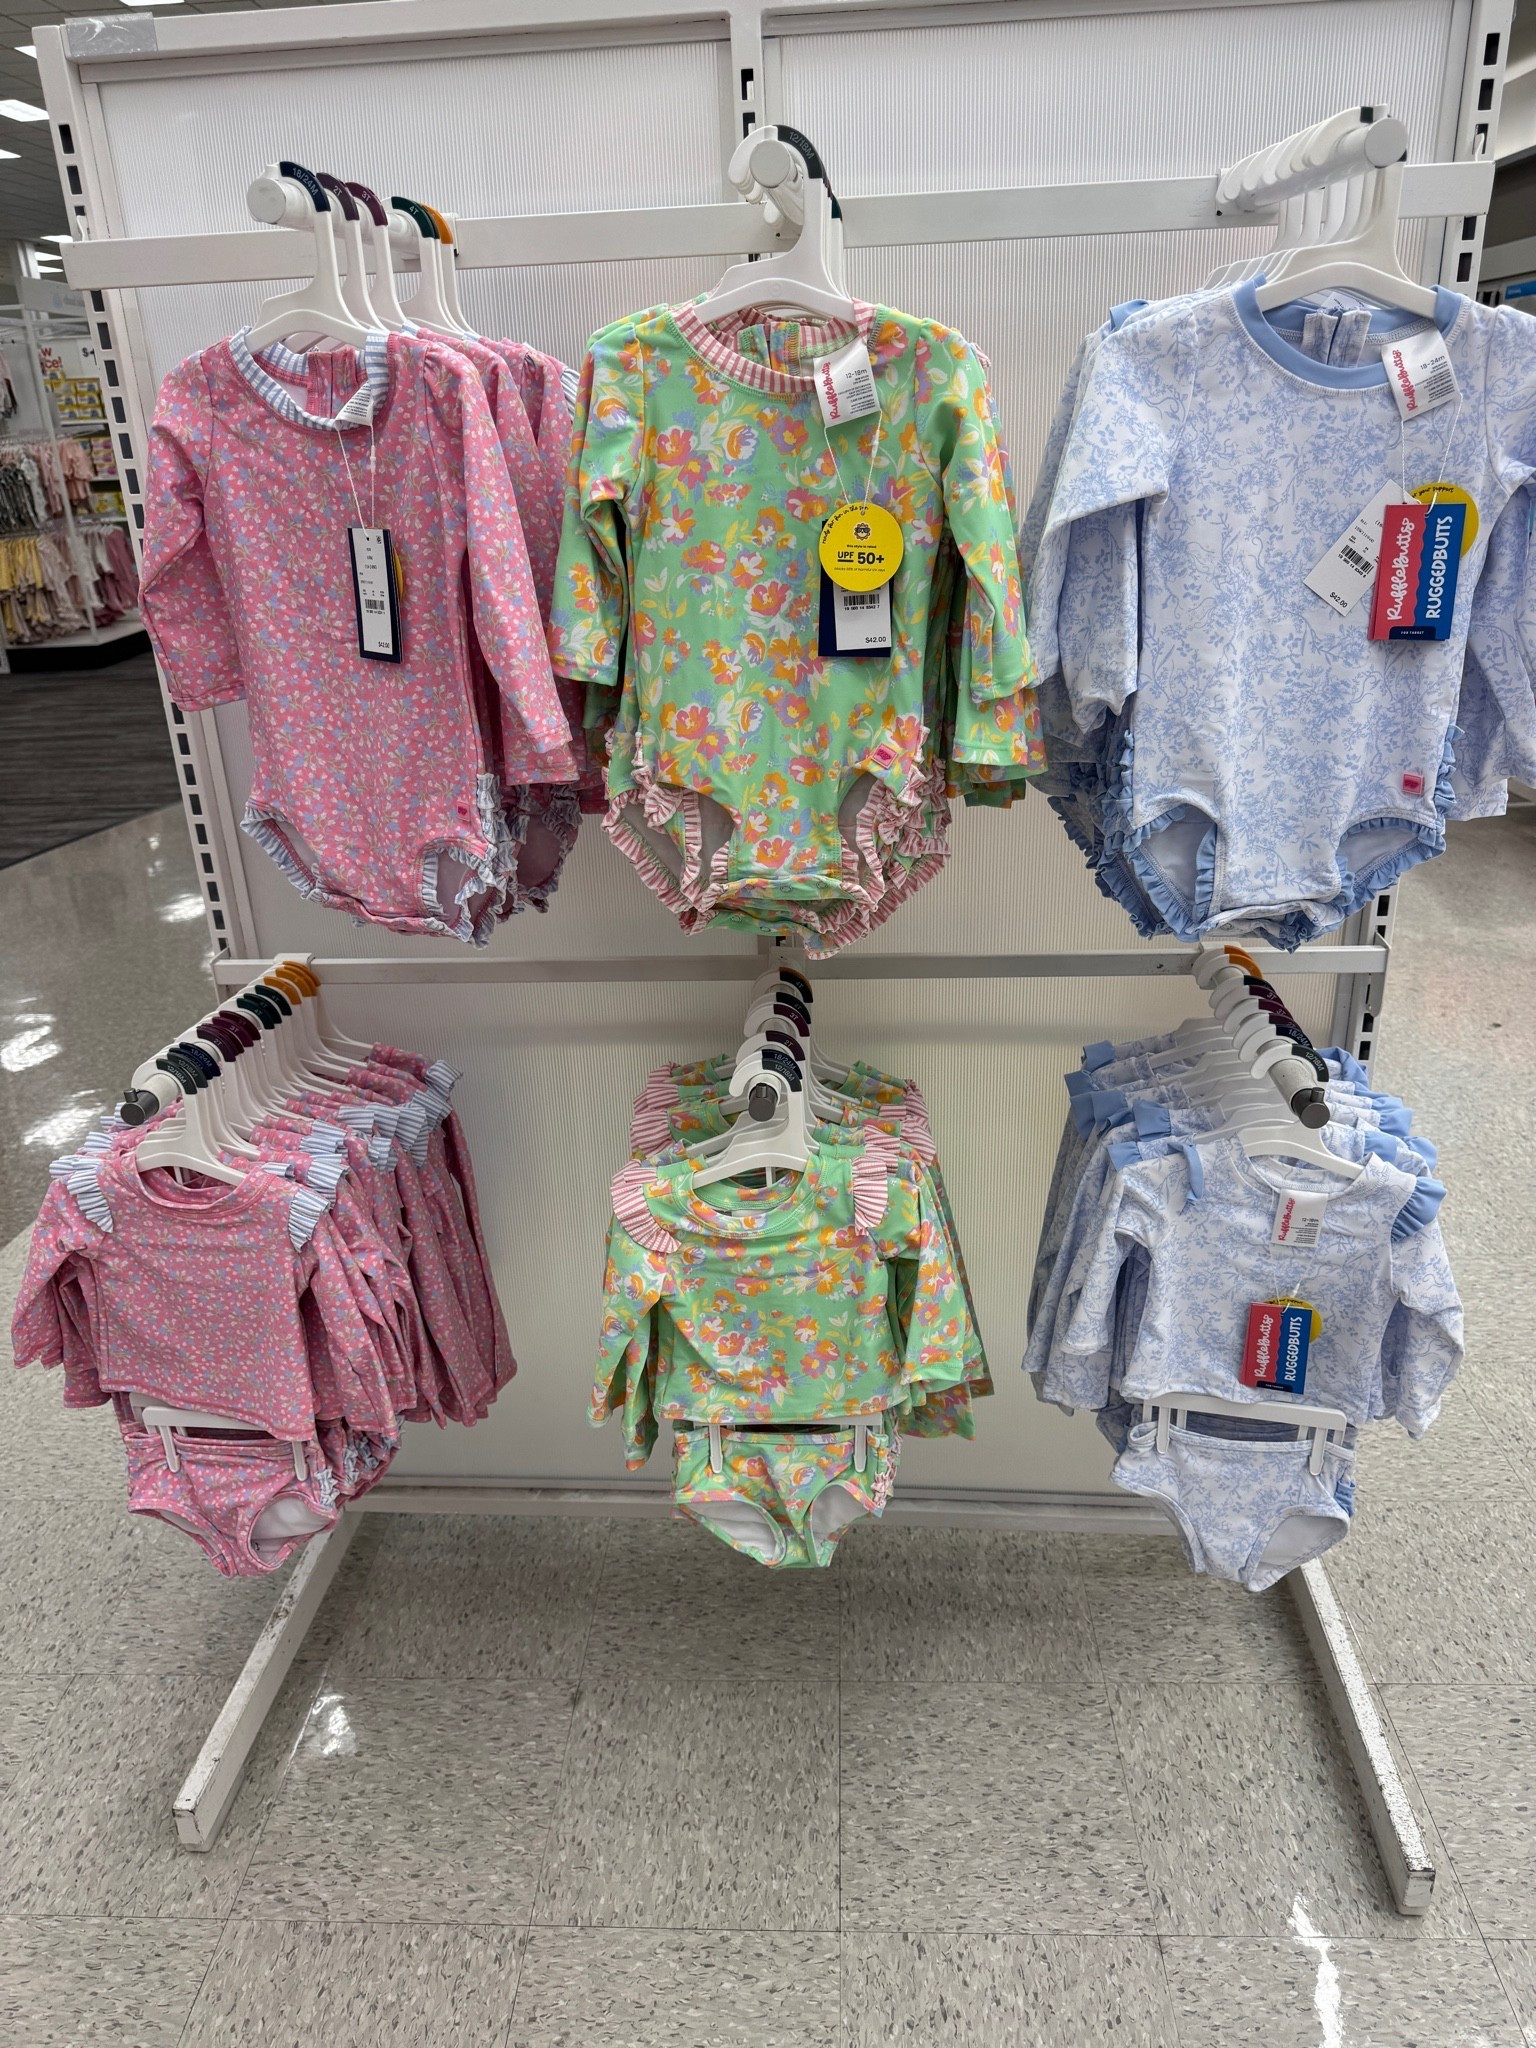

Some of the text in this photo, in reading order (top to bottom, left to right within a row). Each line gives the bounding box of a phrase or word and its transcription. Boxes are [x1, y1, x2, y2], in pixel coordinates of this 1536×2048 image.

[788, 131, 815, 160] 12/18M
[292, 168, 318, 196] 18/24M
[333, 186, 342, 196] 2T
[362, 190, 371, 202] 3T
[409, 206, 419, 215] 4T
[1420, 355, 1446, 370] 18-24m
[846, 368, 868, 379] 12-18m
[837, 551, 854, 559] UPF
[858, 552, 884, 564] 50+
[1426, 516, 1454, 619] RUGGEDBUTTS
[1330, 592, 1348, 608] $42.00
[1266, 992, 1277, 1000] 3T
[1288, 1028, 1310, 1047] 18/24M
[774, 1053, 796, 1070] 18/24M
[1305, 1051, 1325, 1071] 12/18M
[167, 1065, 187, 1084] 12/18M
[774, 1064, 795, 1081] 12/18M
[1284, 1316, 1302, 1382] RUGGEDBUTTS
